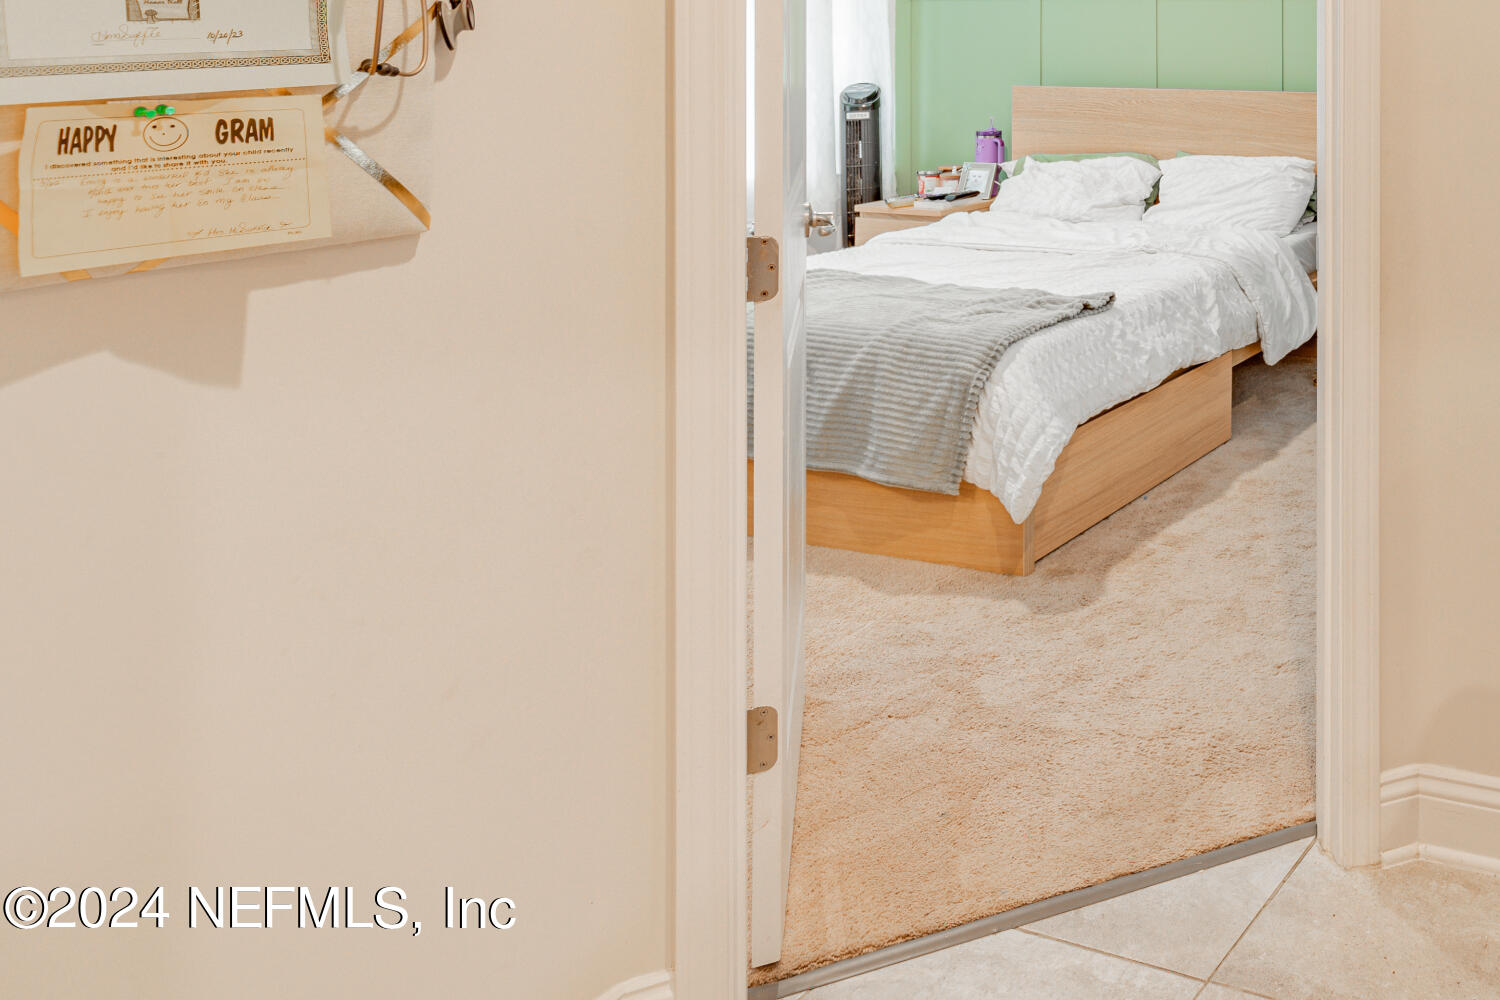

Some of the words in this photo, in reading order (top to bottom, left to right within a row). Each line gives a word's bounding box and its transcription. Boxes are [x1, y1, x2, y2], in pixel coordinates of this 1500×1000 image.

[57, 124, 117, 155] HAPPY
[215, 117, 274, 145] GRAM
[50, 161, 91, 169] discovered
[93, 158, 132, 166] something
[157, 153, 196, 162] interesting
[243, 148, 262, 156] child
